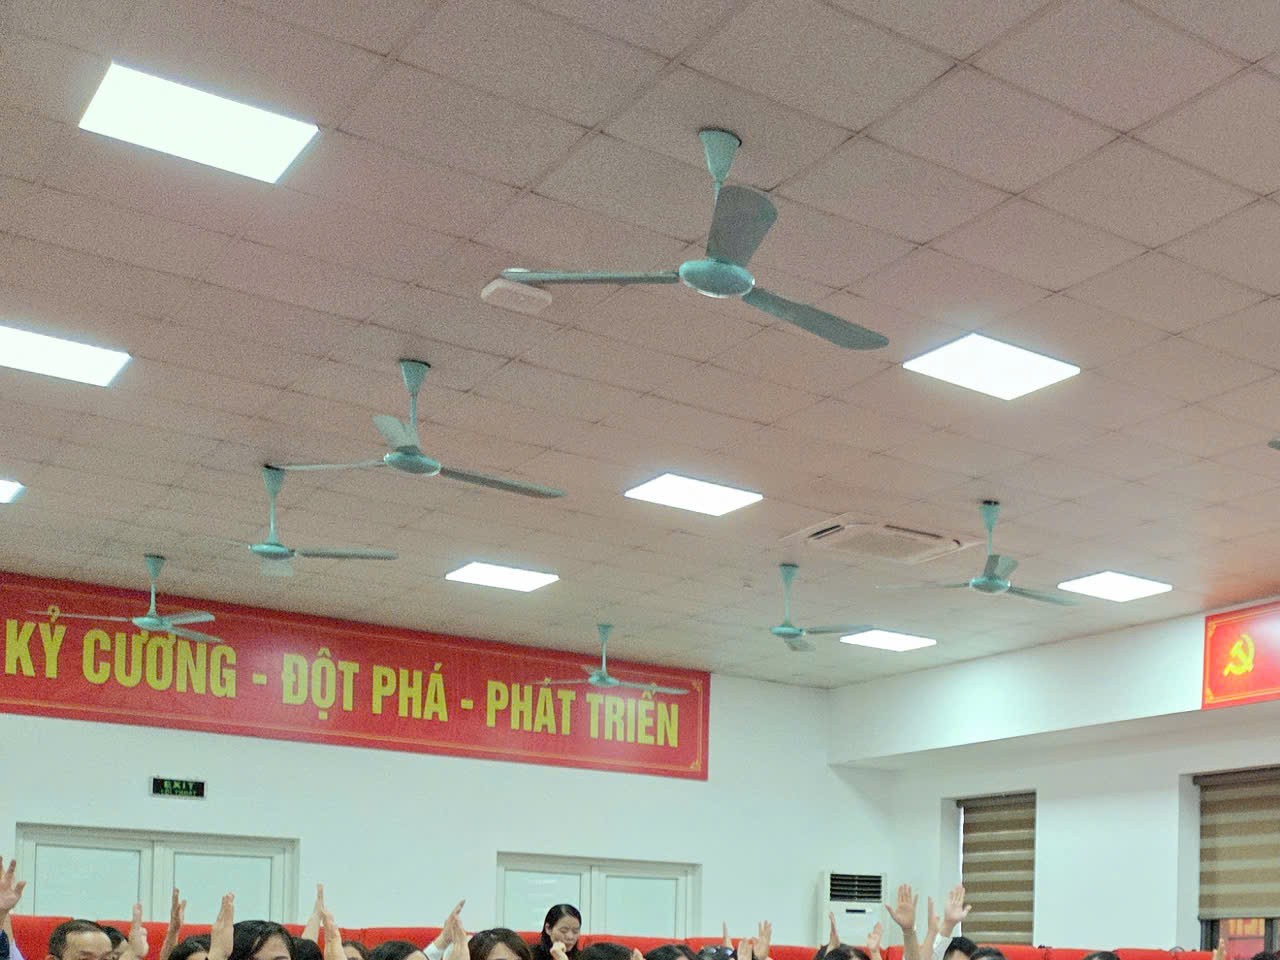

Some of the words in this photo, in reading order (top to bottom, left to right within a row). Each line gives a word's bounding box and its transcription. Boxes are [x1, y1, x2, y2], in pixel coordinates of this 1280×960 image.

[5, 604, 67, 679] KỶ
[83, 628, 237, 698] CƯƠNG
[282, 647, 360, 720] ĐỘT
[372, 662, 449, 722] PHÁ
[486, 677, 576, 735] PHÁT
[586, 682, 679, 748] TRIỂN
